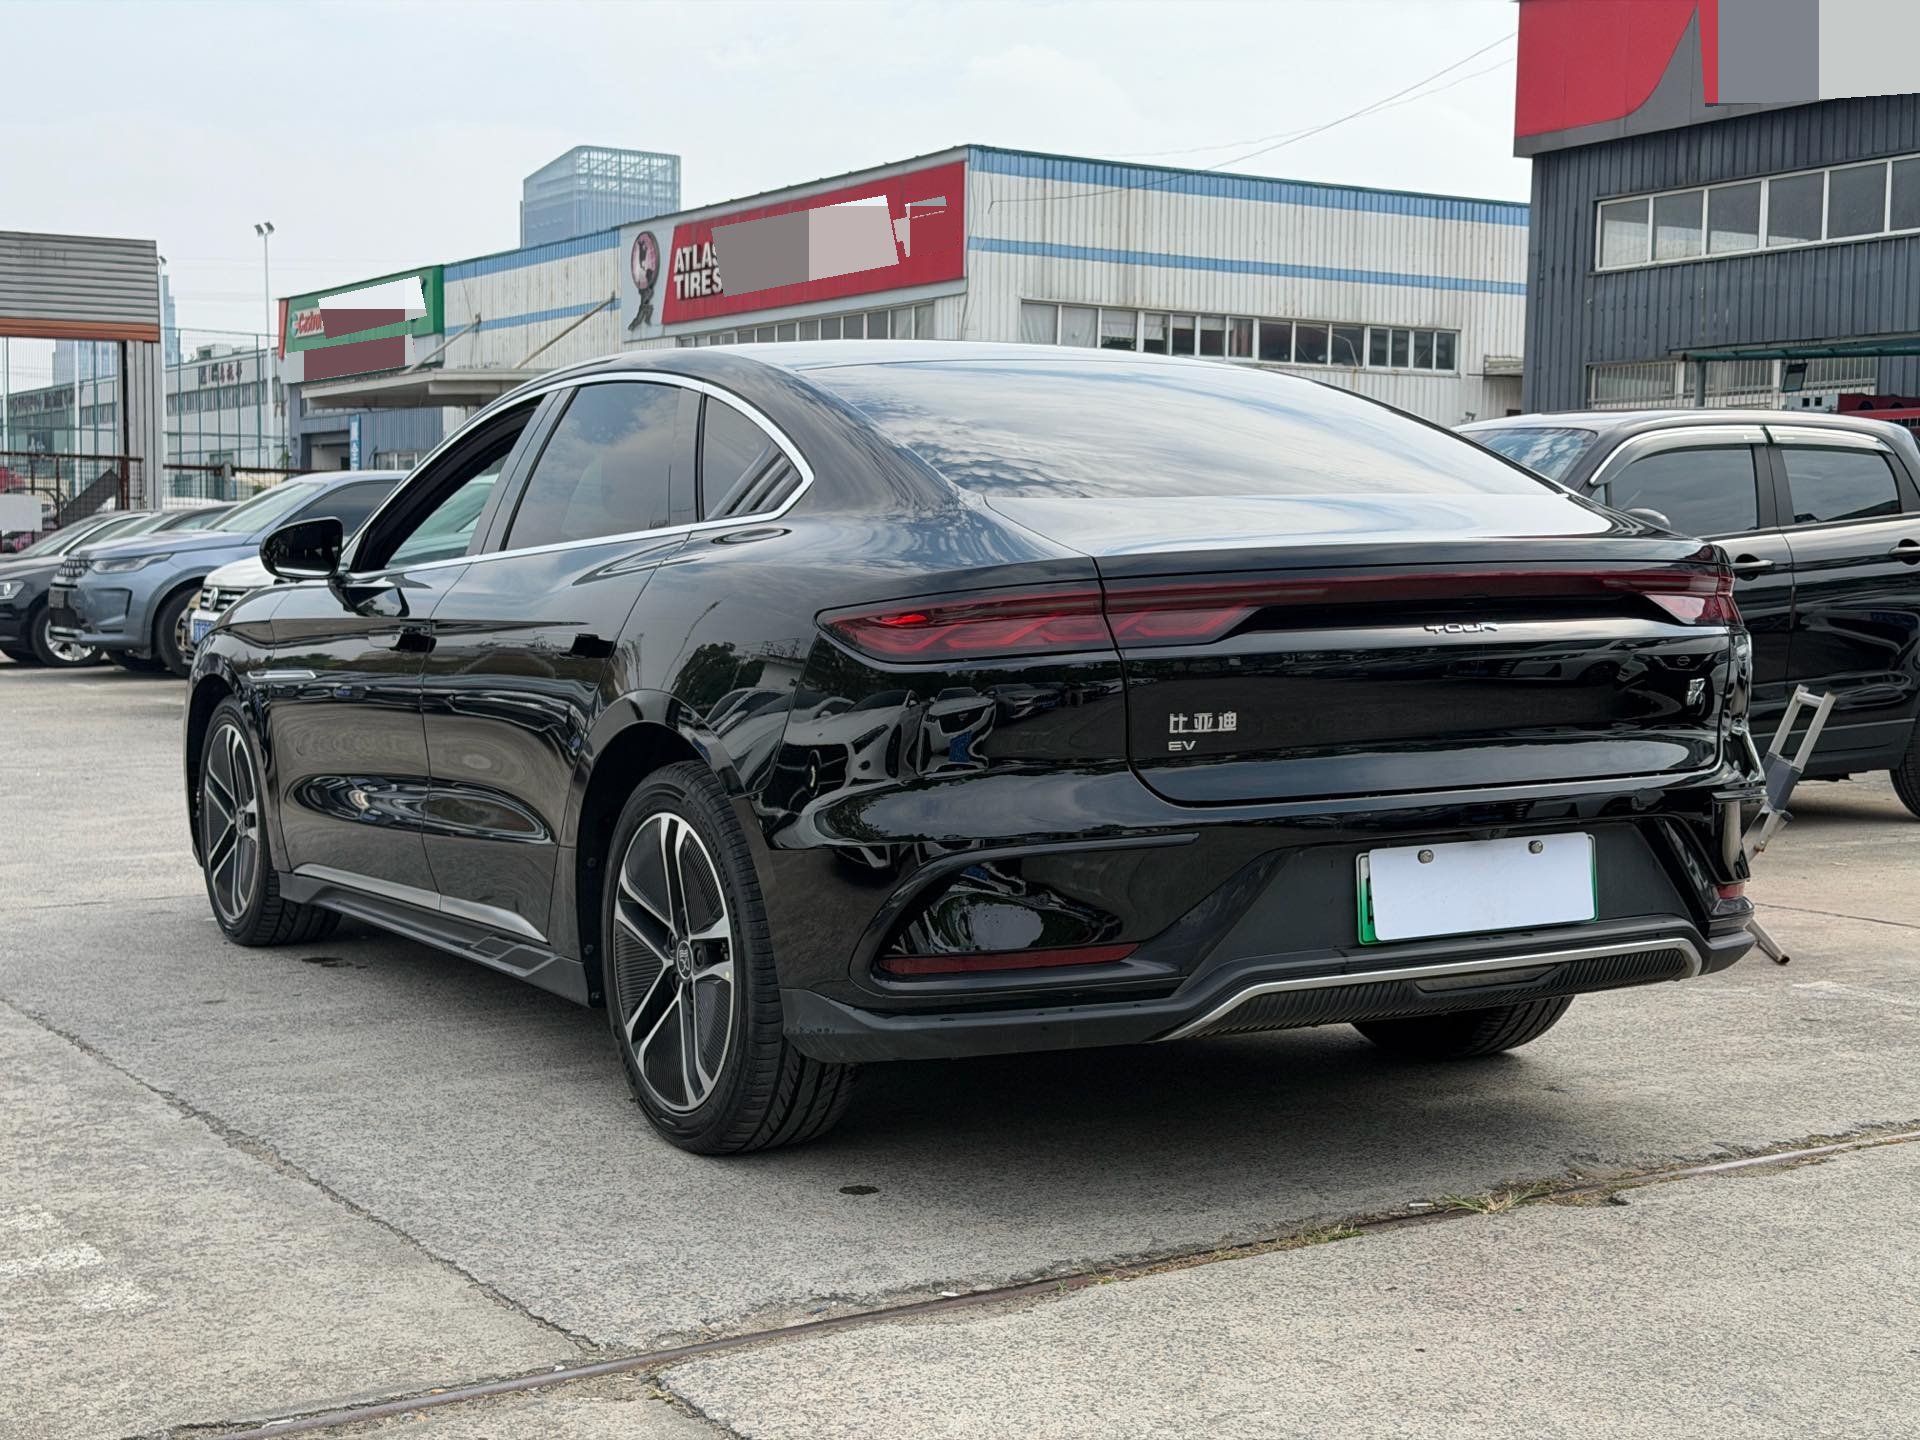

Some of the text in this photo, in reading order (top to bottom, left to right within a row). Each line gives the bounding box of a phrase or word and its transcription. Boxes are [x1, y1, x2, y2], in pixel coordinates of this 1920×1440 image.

[673, 268, 723, 299] TIRES
[1169, 711, 1237, 733] 比亚迪
[1168, 740, 1196, 751] EV
